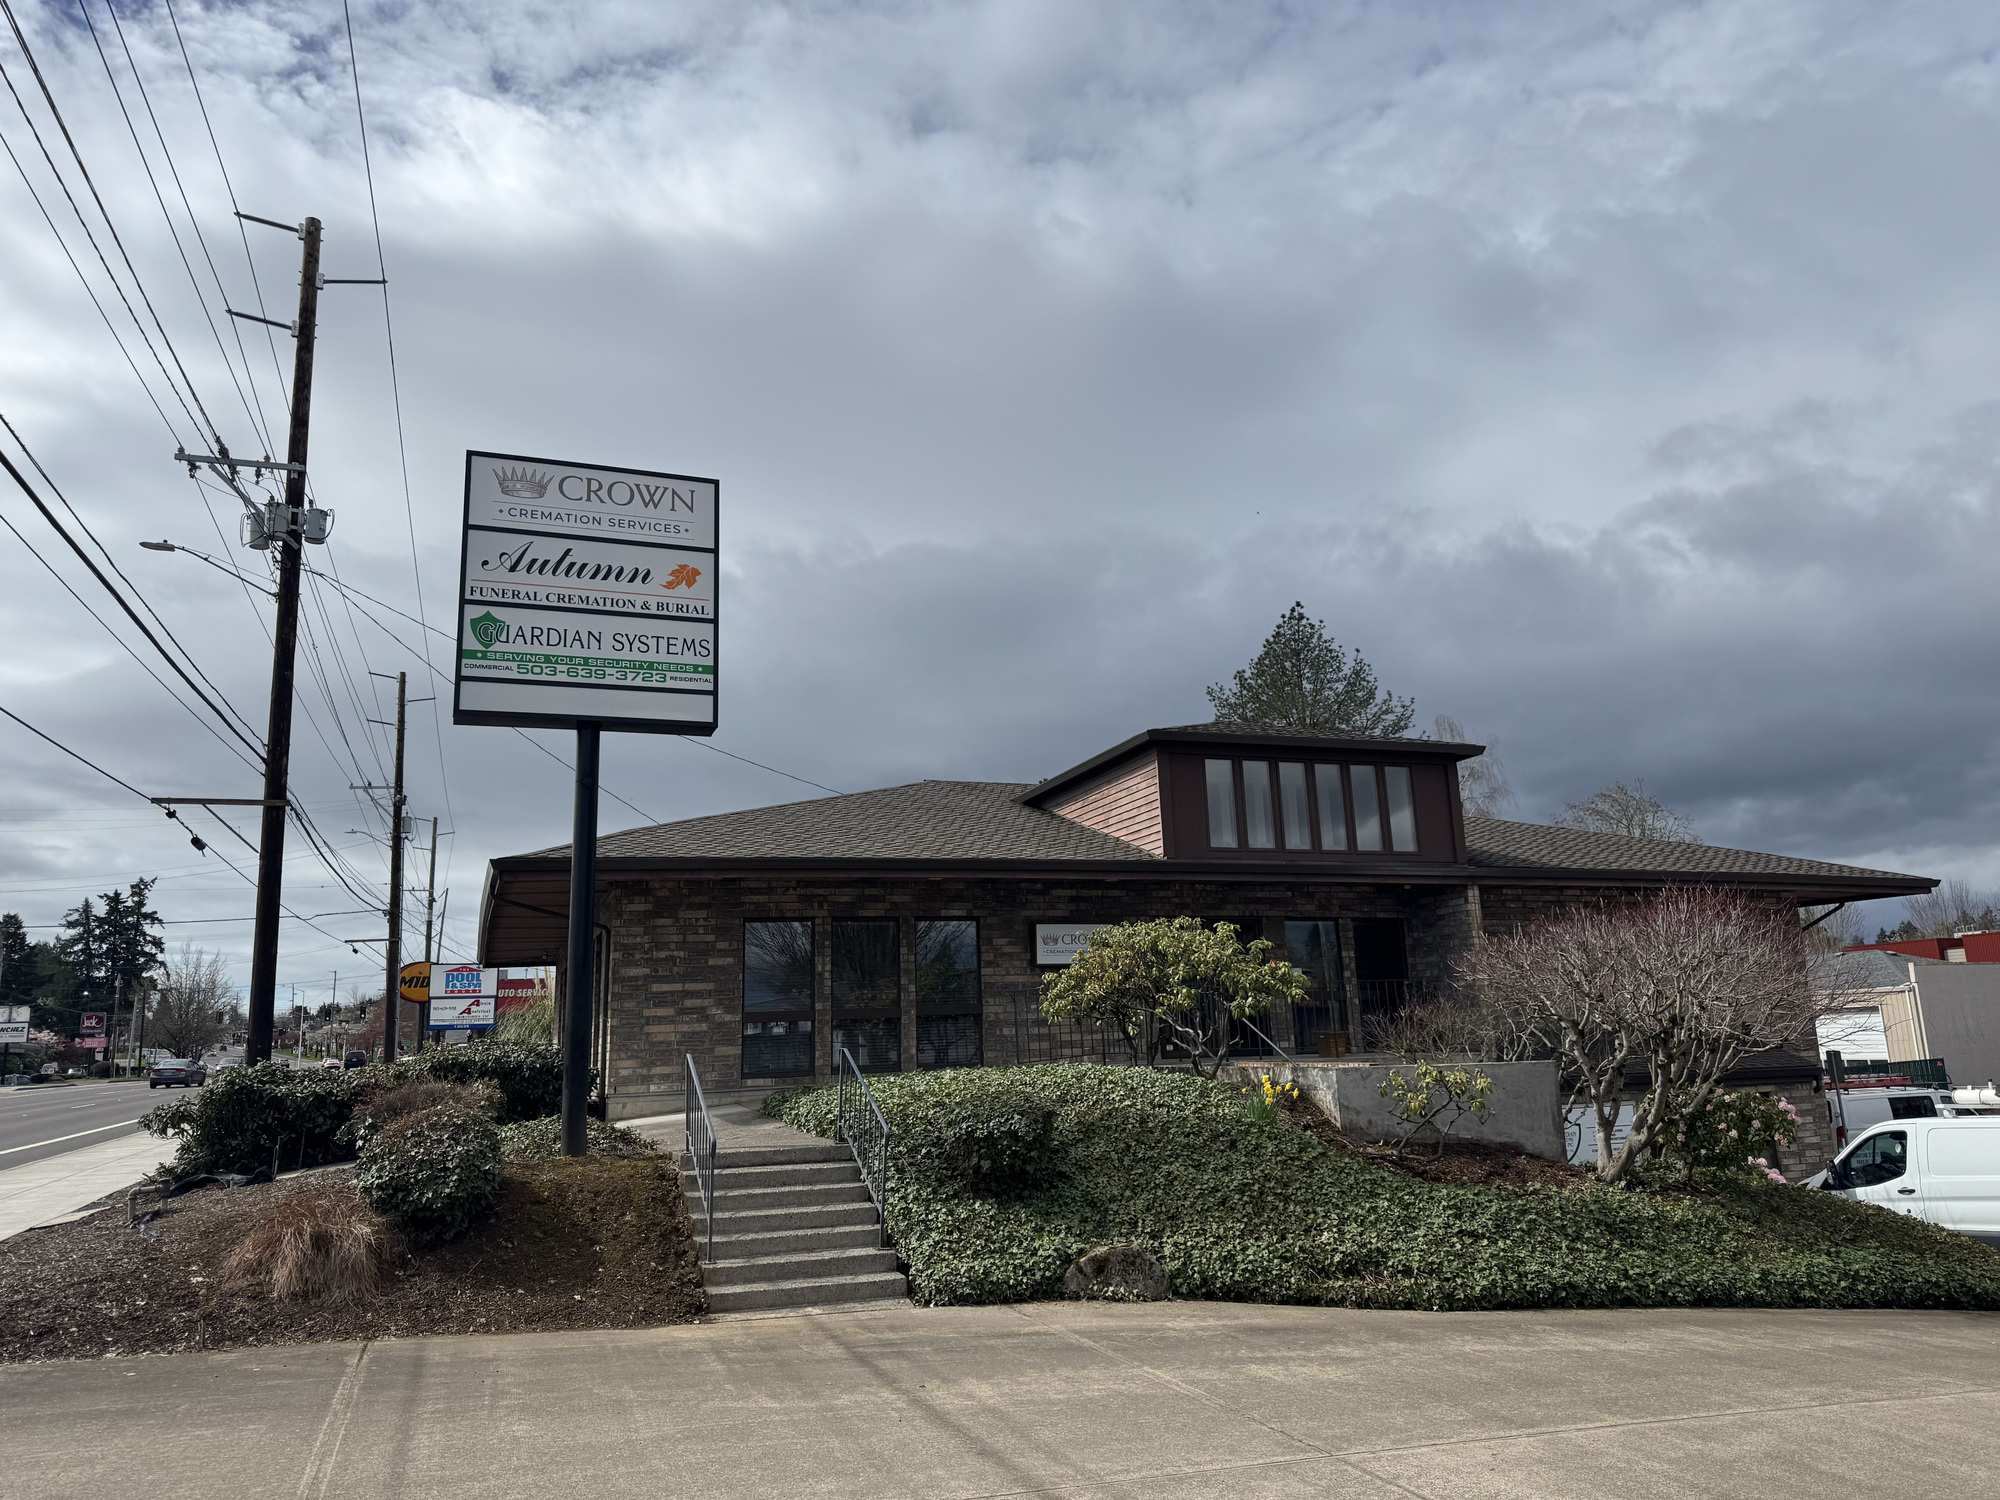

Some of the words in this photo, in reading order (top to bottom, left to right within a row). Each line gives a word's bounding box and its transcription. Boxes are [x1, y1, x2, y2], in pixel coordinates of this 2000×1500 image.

[558, 475, 696, 513] CROWN
[507, 507, 602, 526] CREMATION
[607, 518, 681, 535] SERVICES
[481, 541, 654, 585] Autumn
[469, 585, 542, 603] FUNERAL
[545, 592, 637, 612] CREMATION
[640, 599, 653, 611] &
[656, 602, 710, 616] BURIAL
[477, 621, 602, 651] GUARDIAN
[612, 631, 711, 658] SYSTEMS
[464, 662, 514, 672] COMMERCIAL
[516, 663, 667, 683] 503-639-3723
[669, 675, 713, 684] RESIDENTIAL
[486, 651, 545, 663] SERVING
[548, 654, 584, 666] YOUR
[588, 657, 649, 669] SECURITY
[653, 662, 694, 672] NEEDS
[1061, 934, 1088, 945] CRO
[498, 988, 515, 997] UTO
